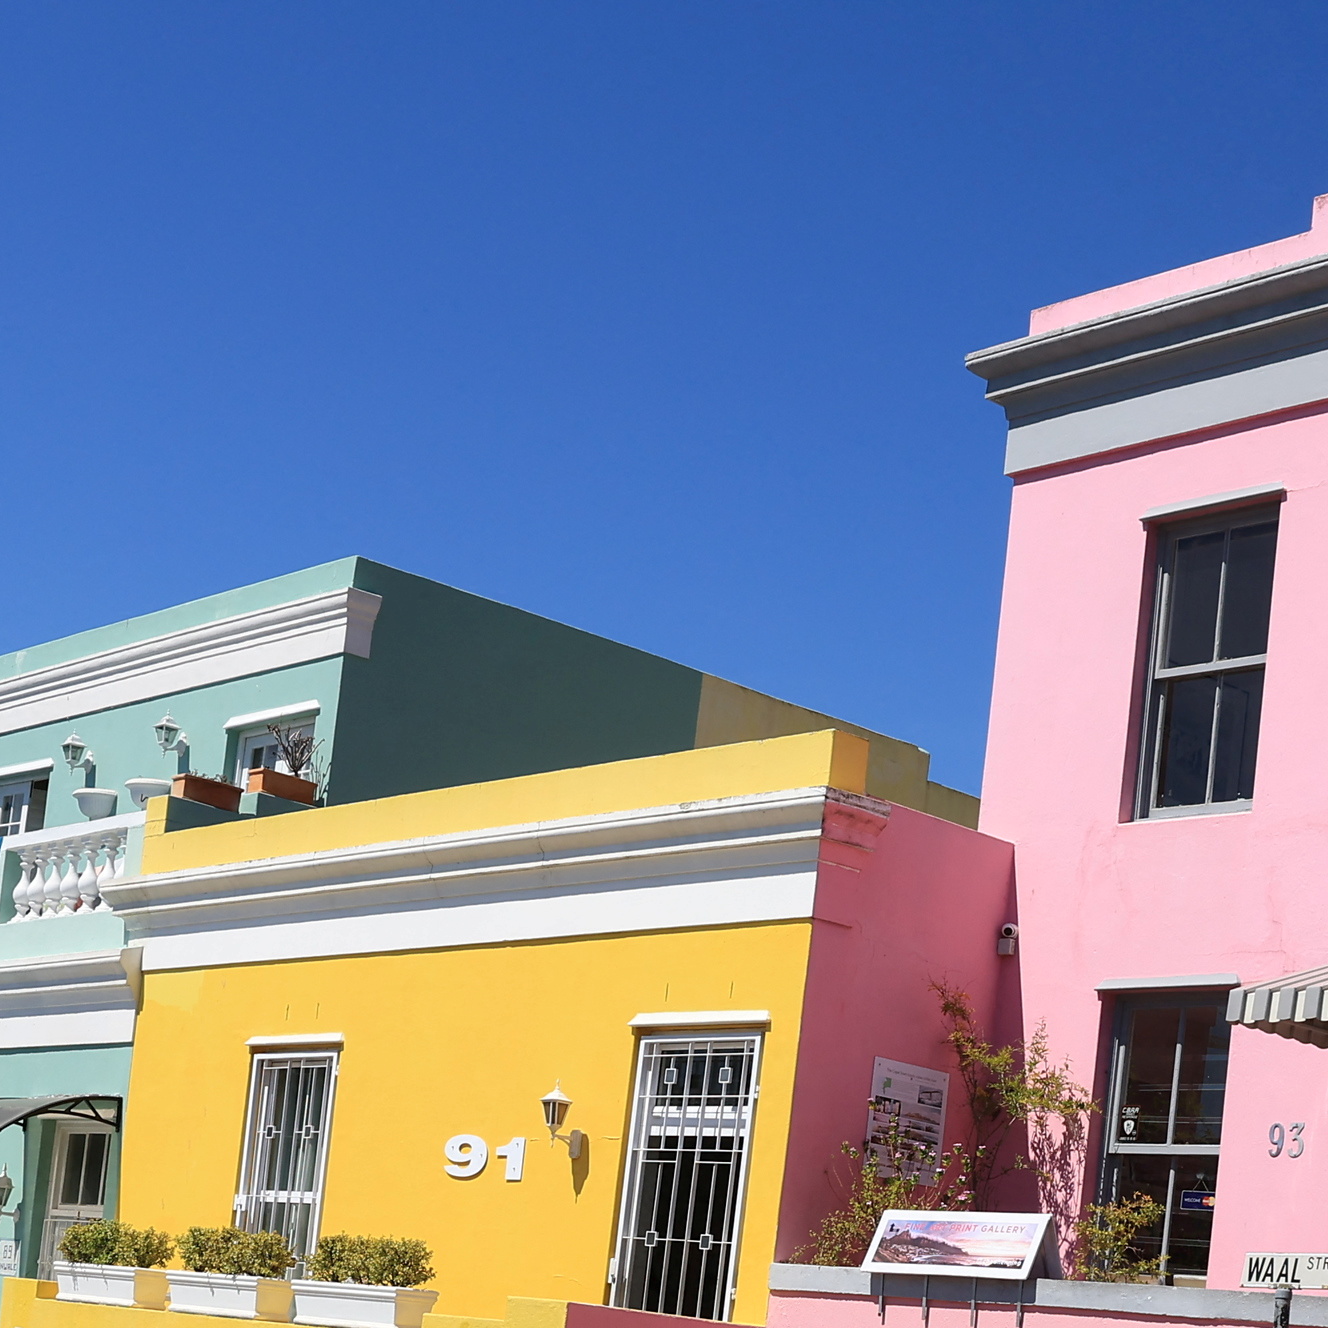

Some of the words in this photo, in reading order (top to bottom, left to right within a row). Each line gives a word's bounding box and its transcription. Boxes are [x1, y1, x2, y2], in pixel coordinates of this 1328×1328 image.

[1267, 1122, 1306, 1159] 93
[443, 1133, 527, 1183] 91
[904, 1223, 926, 1231] FINE
[929, 1223, 947, 1232] ART
[950, 1224, 979, 1233] PRINT
[981, 1225, 1027, 1234] GALLERY
[3, 1244, 13, 1259] 89
[1247, 1257, 1302, 1284] WAAL
